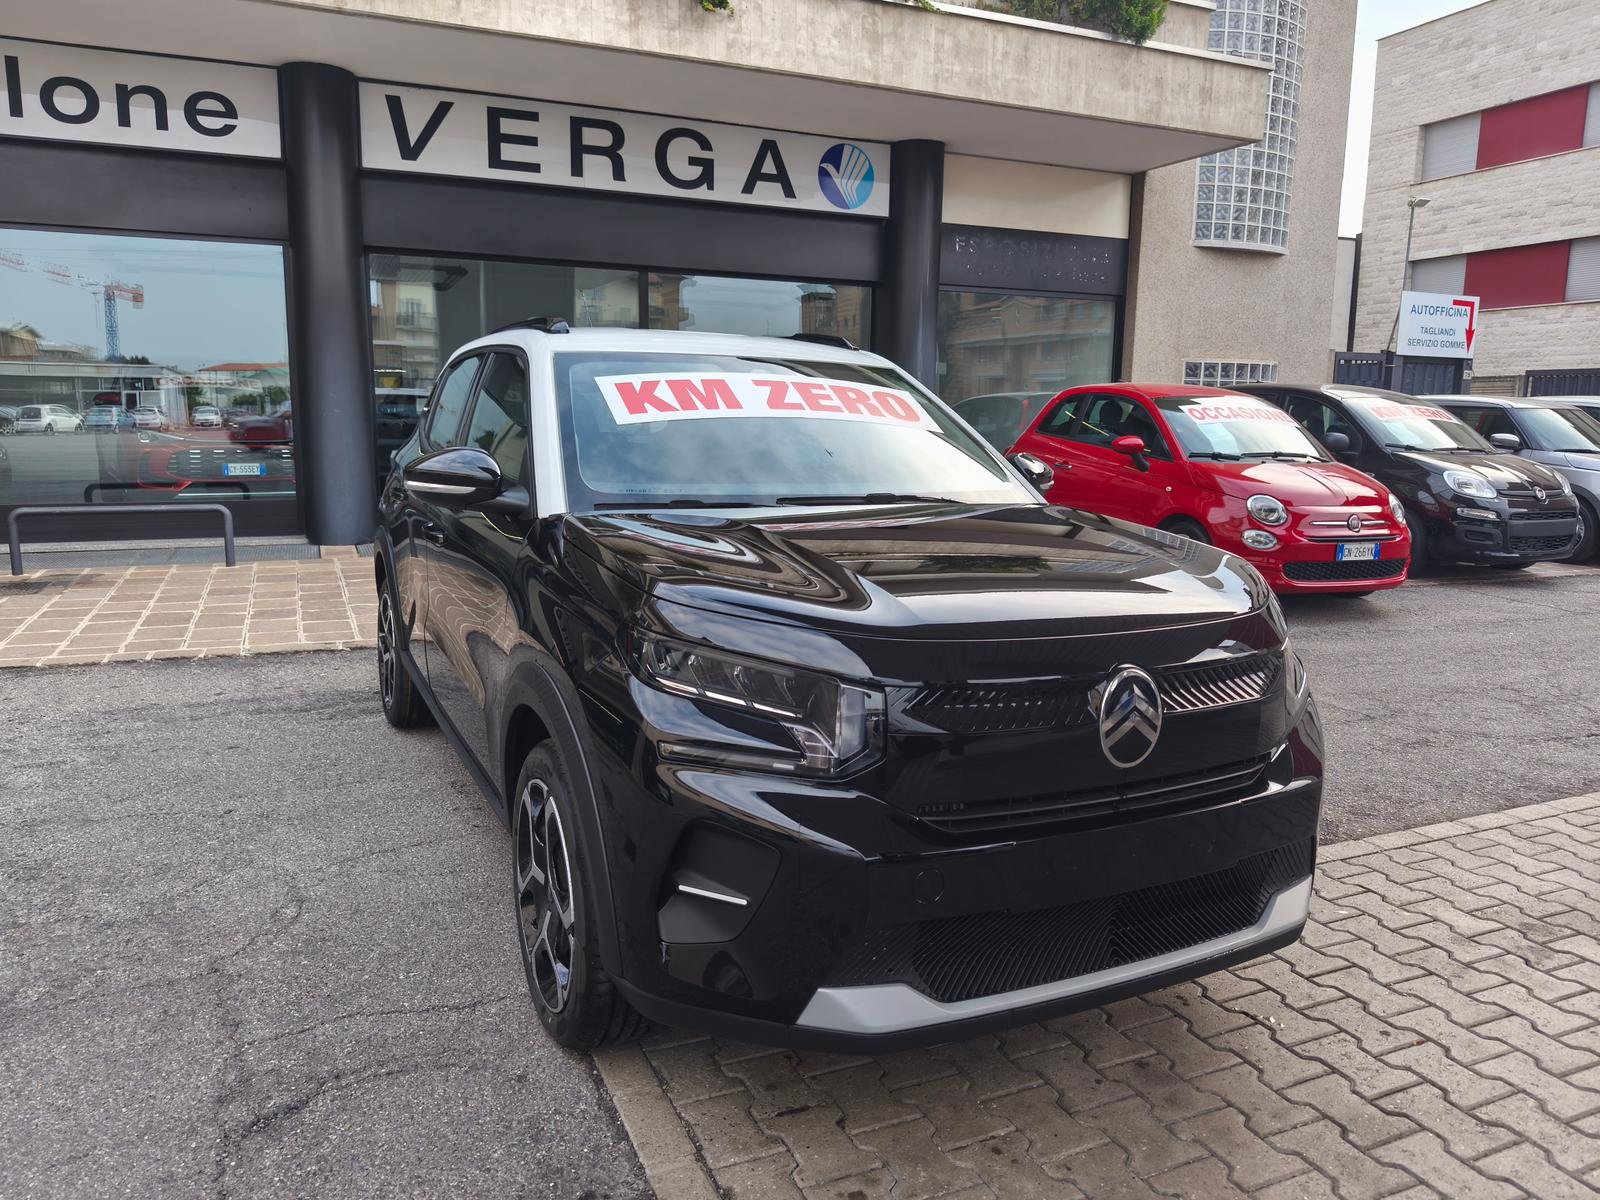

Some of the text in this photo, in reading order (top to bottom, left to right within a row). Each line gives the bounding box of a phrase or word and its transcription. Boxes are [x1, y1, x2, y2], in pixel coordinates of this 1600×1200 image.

[384, 94, 797, 199] VERGA
[1410, 304, 1468, 318] AUTOFFICINA
[1420, 326, 1456, 336] TAGLIANDI
[1407, 338, 1465, 349] SERVIZIO GOMME
[614, 379, 921, 422] KM ZERO
[1187, 406, 1292, 422] OCCASIONE
